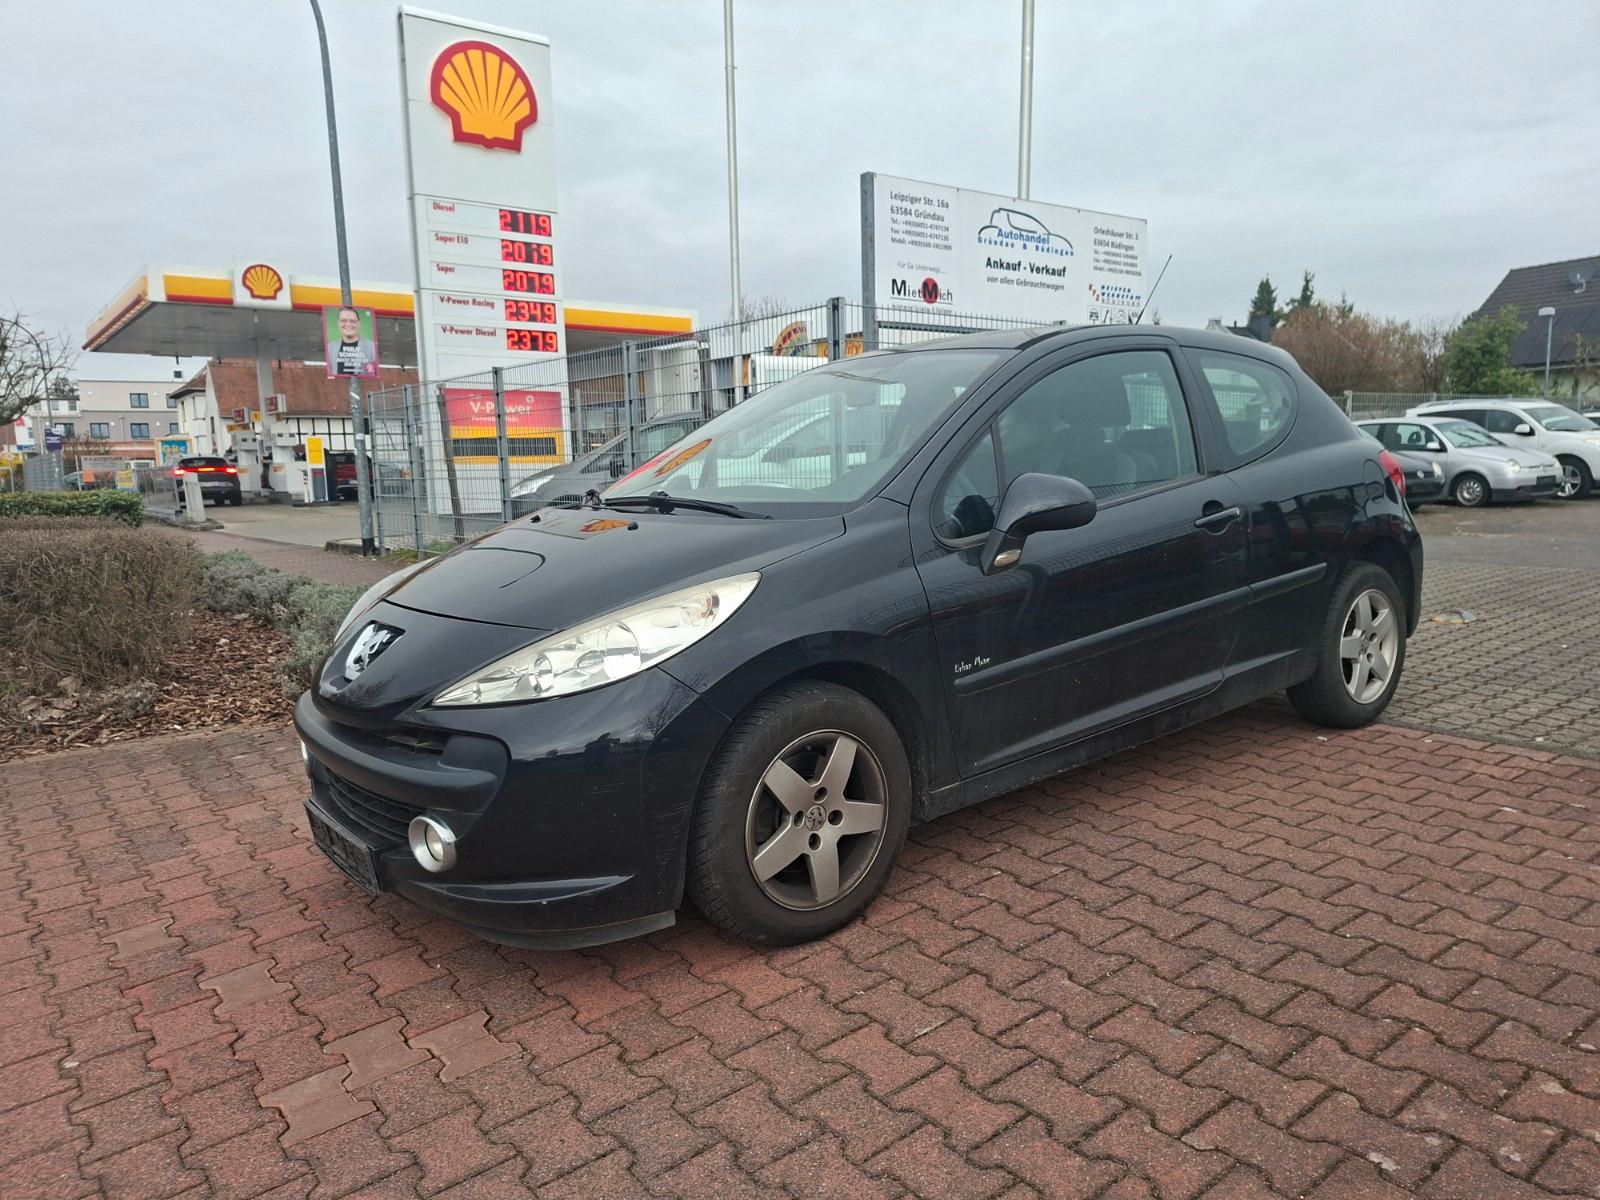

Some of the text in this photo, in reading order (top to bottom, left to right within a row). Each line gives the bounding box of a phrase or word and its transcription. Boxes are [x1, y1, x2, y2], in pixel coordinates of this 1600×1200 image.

[432, 202, 455, 212] Diesel
[890, 192, 949, 208] Leipziger Str. 16a
[890, 206, 944, 222] 63584 Gründau
[434, 233, 468, 244] Super E10
[997, 228, 1050, 245] Autohandel
[978, 236, 1014, 248] Gründau
[1035, 245, 1074, 256] Büdingen
[436, 264, 455, 274] Super
[986, 257, 1022, 272] Ankauf
[1029, 262, 1066, 278] Verkauf
[1000, 276, 1014, 285] allen
[1016, 279, 1064, 292] Gebrauchtwagen
[440, 296, 495, 309] V-Power Racing
[441, 325, 496, 336] V-Power Diesel
[470, 400, 532, 415] V-Pwer
[954, 661, 972, 672] Urban
